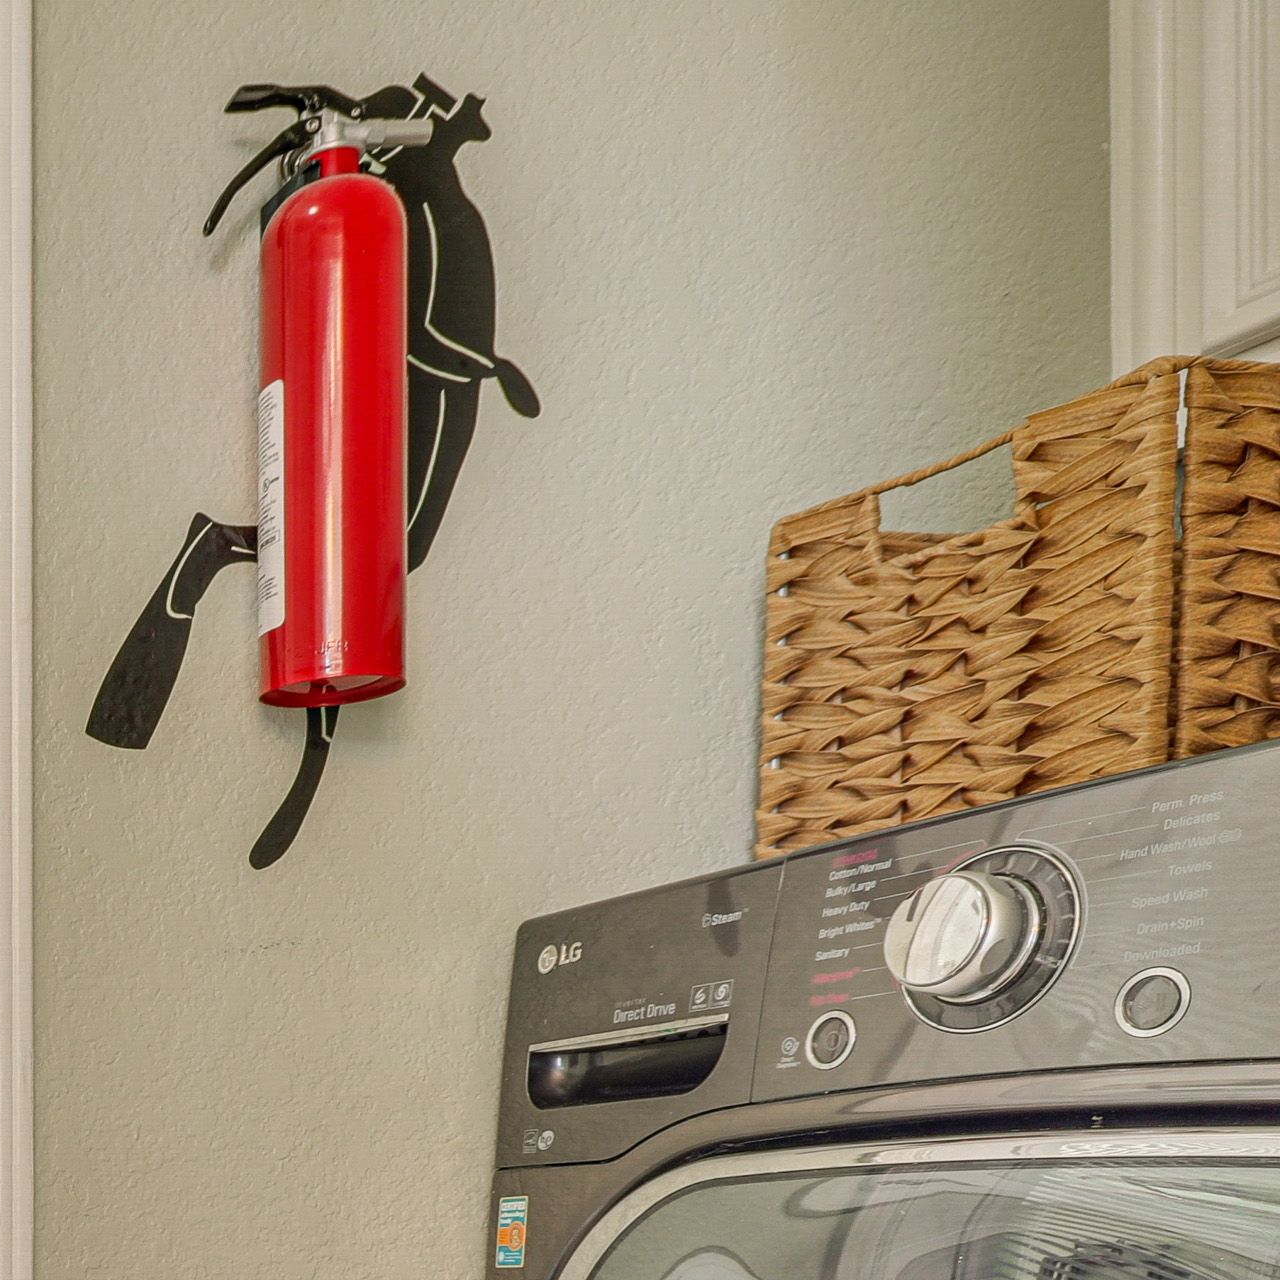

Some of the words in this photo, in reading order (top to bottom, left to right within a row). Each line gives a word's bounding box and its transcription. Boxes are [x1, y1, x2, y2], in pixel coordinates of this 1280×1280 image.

[1188, 790, 1225, 806] Press
[1163, 811, 1221, 830] Delicates
[1120, 845, 1149, 860] Hand
[1168, 860, 1213, 877] Towels
[1131, 892, 1170, 909] Speed
[1172, 886, 1209, 902] Wash
[559, 941, 583, 965] LG
[1123, 942, 1202, 962] Downloaded
[613, 1006, 646, 1024] Direct
[646, 1003, 676, 1018] Drive
